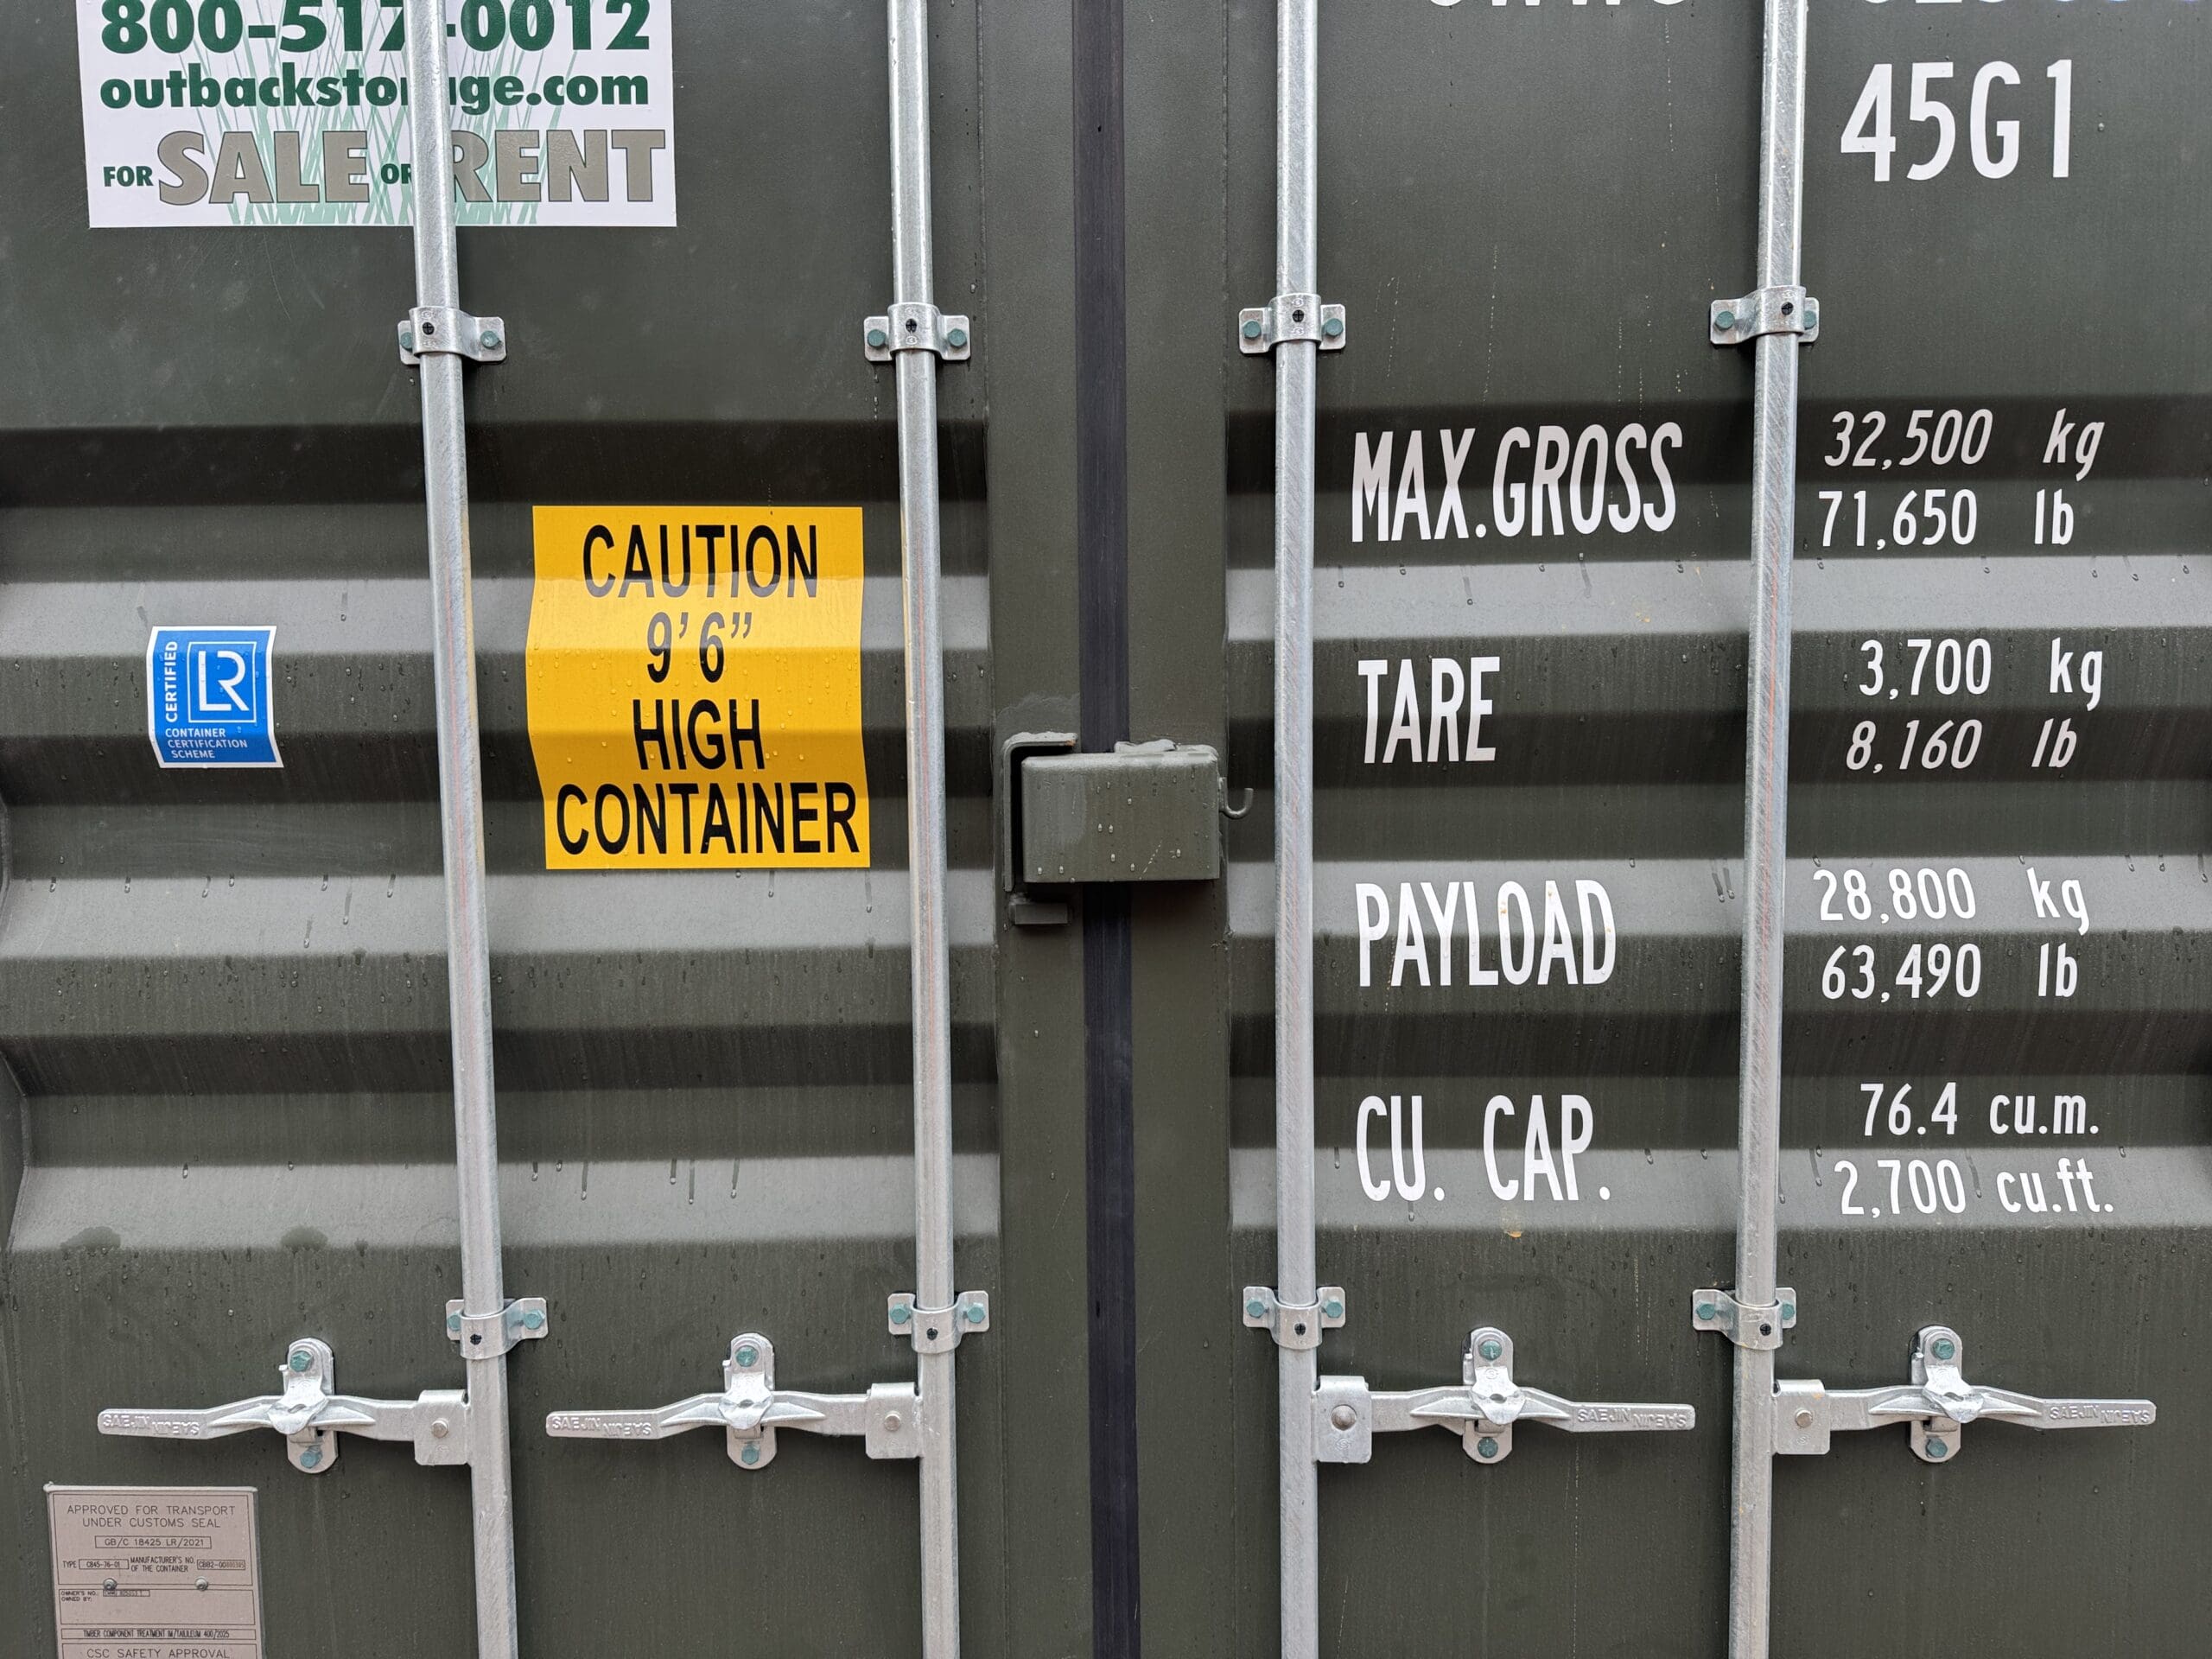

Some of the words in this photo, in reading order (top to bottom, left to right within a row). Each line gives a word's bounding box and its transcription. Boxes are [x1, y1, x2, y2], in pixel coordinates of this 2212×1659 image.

[1841, 60, 2071, 181] 45G1
[104, 166, 153, 187] FOR
[157, 130, 370, 206] SALE
[451, 130, 665, 203] RENT
[1825, 410, 1992, 469] 32,500
[2044, 409, 2104, 481] kg
[1819, 489, 1976, 550] 71,650
[2035, 489, 2074, 545] lb
[583, 524, 817, 598] CAUTION
[164, 641, 178, 722] CERTIFIED
[198, 651, 250, 711] LR
[1358, 657, 1500, 764] TARE
[1859, 639, 1992, 700] 3,700
[2050, 638, 2103, 710] kg
[165, 728, 226, 738] CONTAINER
[168, 739, 248, 749] CERTIFICATION
[172, 749, 215, 759] SCHEME
[632, 699, 765, 770] HIGH
[1846, 720, 1982, 773] 8,160
[2031, 719, 2077, 768] lb
[556, 782, 860, 855] CONTAINER
[1355, 880, 1616, 987] PAYLOAD
[1813, 868, 1976, 924] 28,800
[2027, 868, 2090, 935] kg
[1821, 944, 1981, 1002] 63,490
[2038, 944, 2077, 997] lb
[1357, 1096, 1445, 1201] CU.
[1484, 1095, 1611, 1201] CAP.
[1860, 1083, 1958, 1136] 76.4
[1989, 1095, 2099, 1135] cu.m.
[1834, 1160, 1967, 1218] 2,700
[1997, 1158, 2113, 1212] cu.ft.
[67, 1505, 128, 1515] APPROVED
[136, 1505, 158, 1516] FOR
[166, 1505, 236, 1516] TRANSPORT
[82, 1518, 122, 1528] UNDER
[130, 1518, 184, 1528] CUSTOMS
[192, 1518, 221, 1529] SEAL
[104, 1537, 129, 1548] GB/C
[134, 1538, 162, 1547] 18425
[166, 1537, 204, 1548] LR/2021
[87, 1649, 110, 1659] CSC
[118, 1649, 162, 1659] SAFETY
[168, 1649, 231, 1659] APPROVAL
[103, 1630, 133, 1638] COMPONENT
[137, 1630, 166, 1638] TREATMENT
